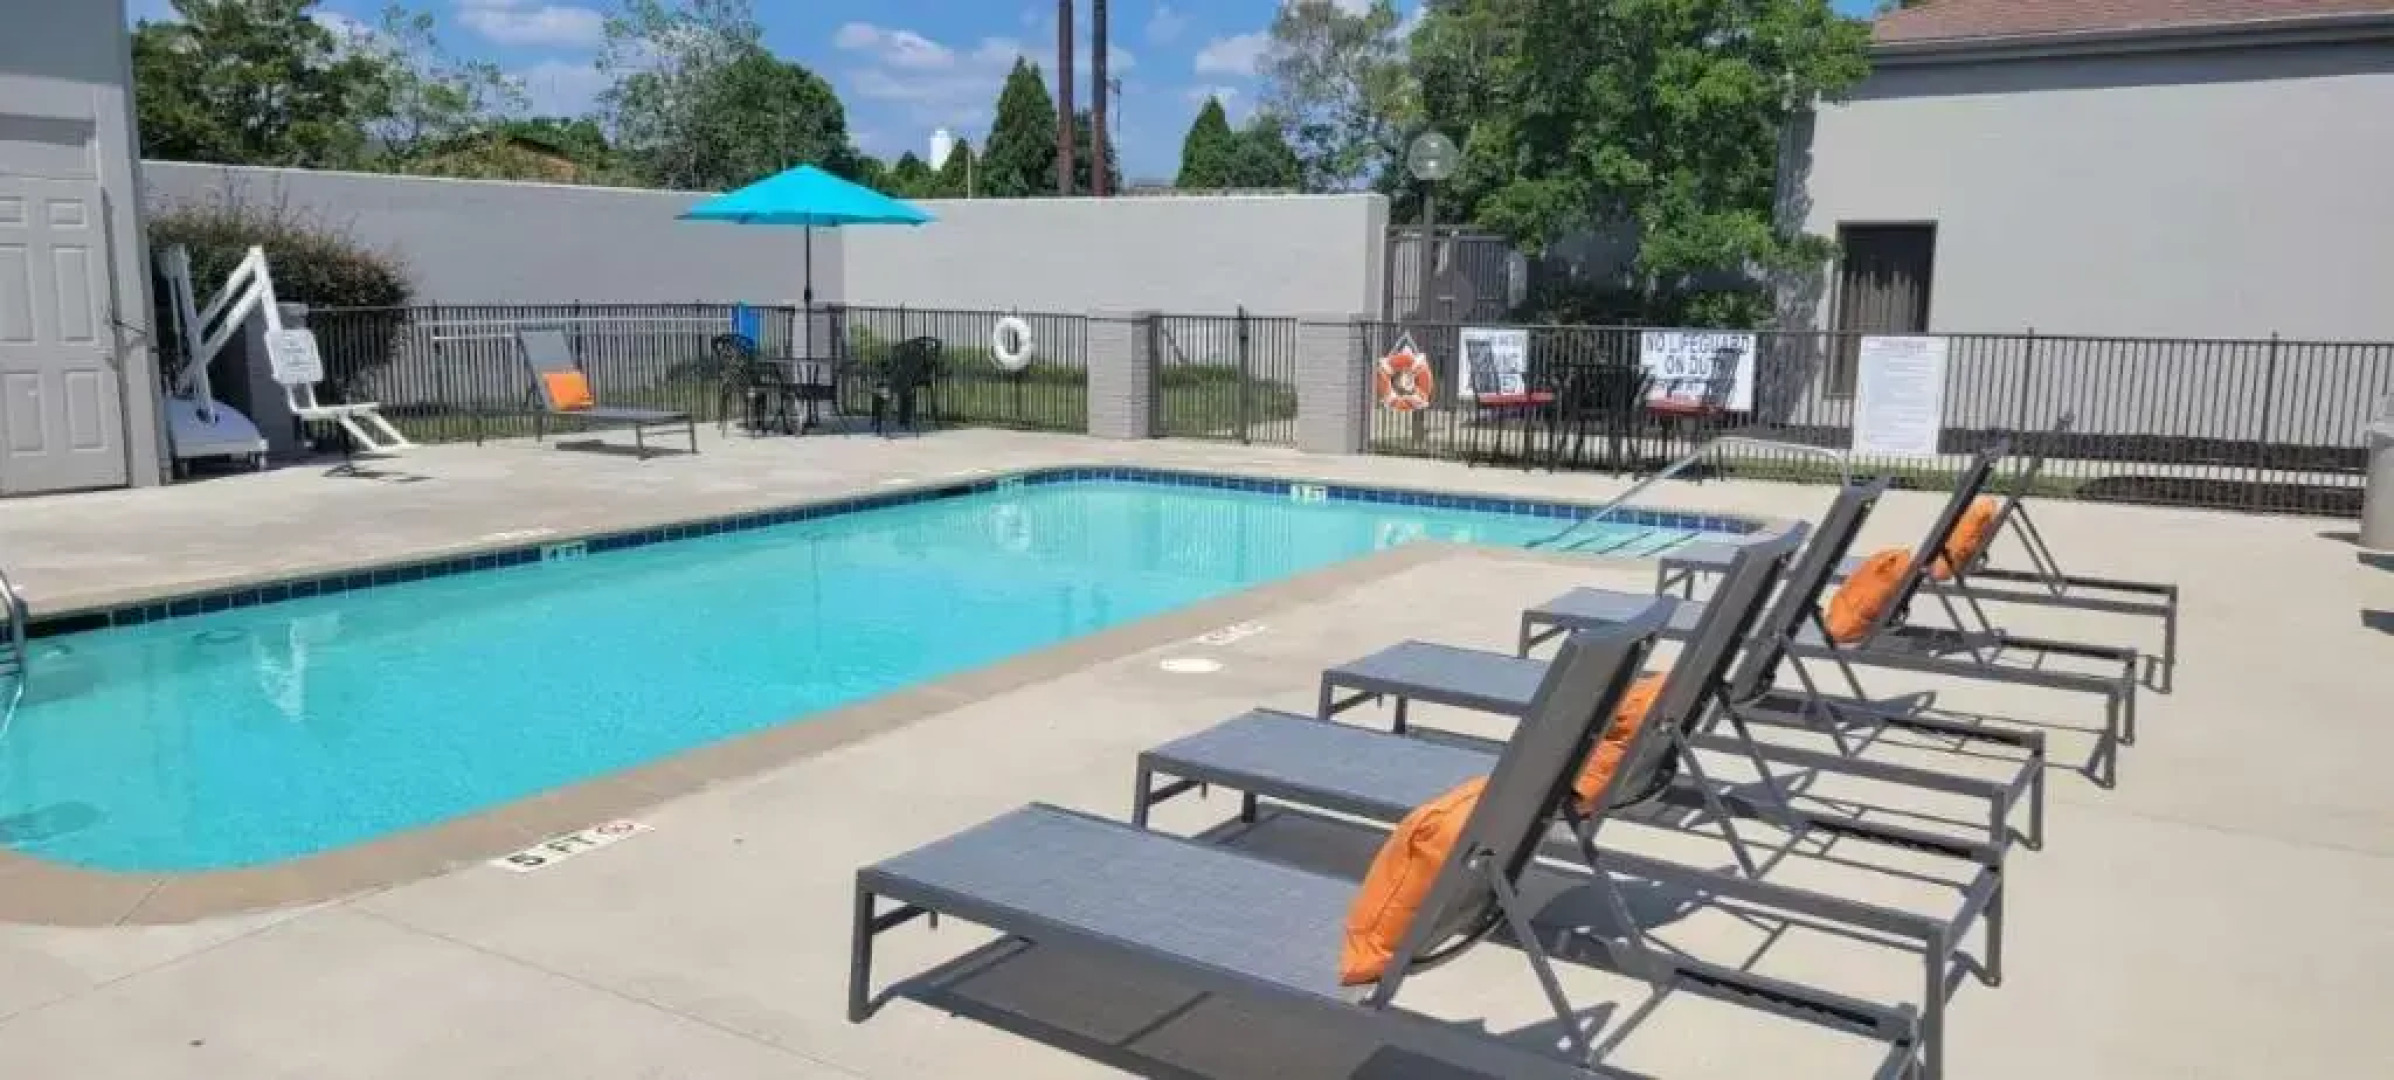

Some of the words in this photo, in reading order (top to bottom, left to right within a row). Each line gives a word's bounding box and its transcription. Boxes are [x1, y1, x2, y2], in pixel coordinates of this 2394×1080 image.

[1645, 333, 1664, 354] NO
[1665, 354, 1685, 375] ON
[507, 853, 546, 867] 5
[546, 834, 596, 854] FT
